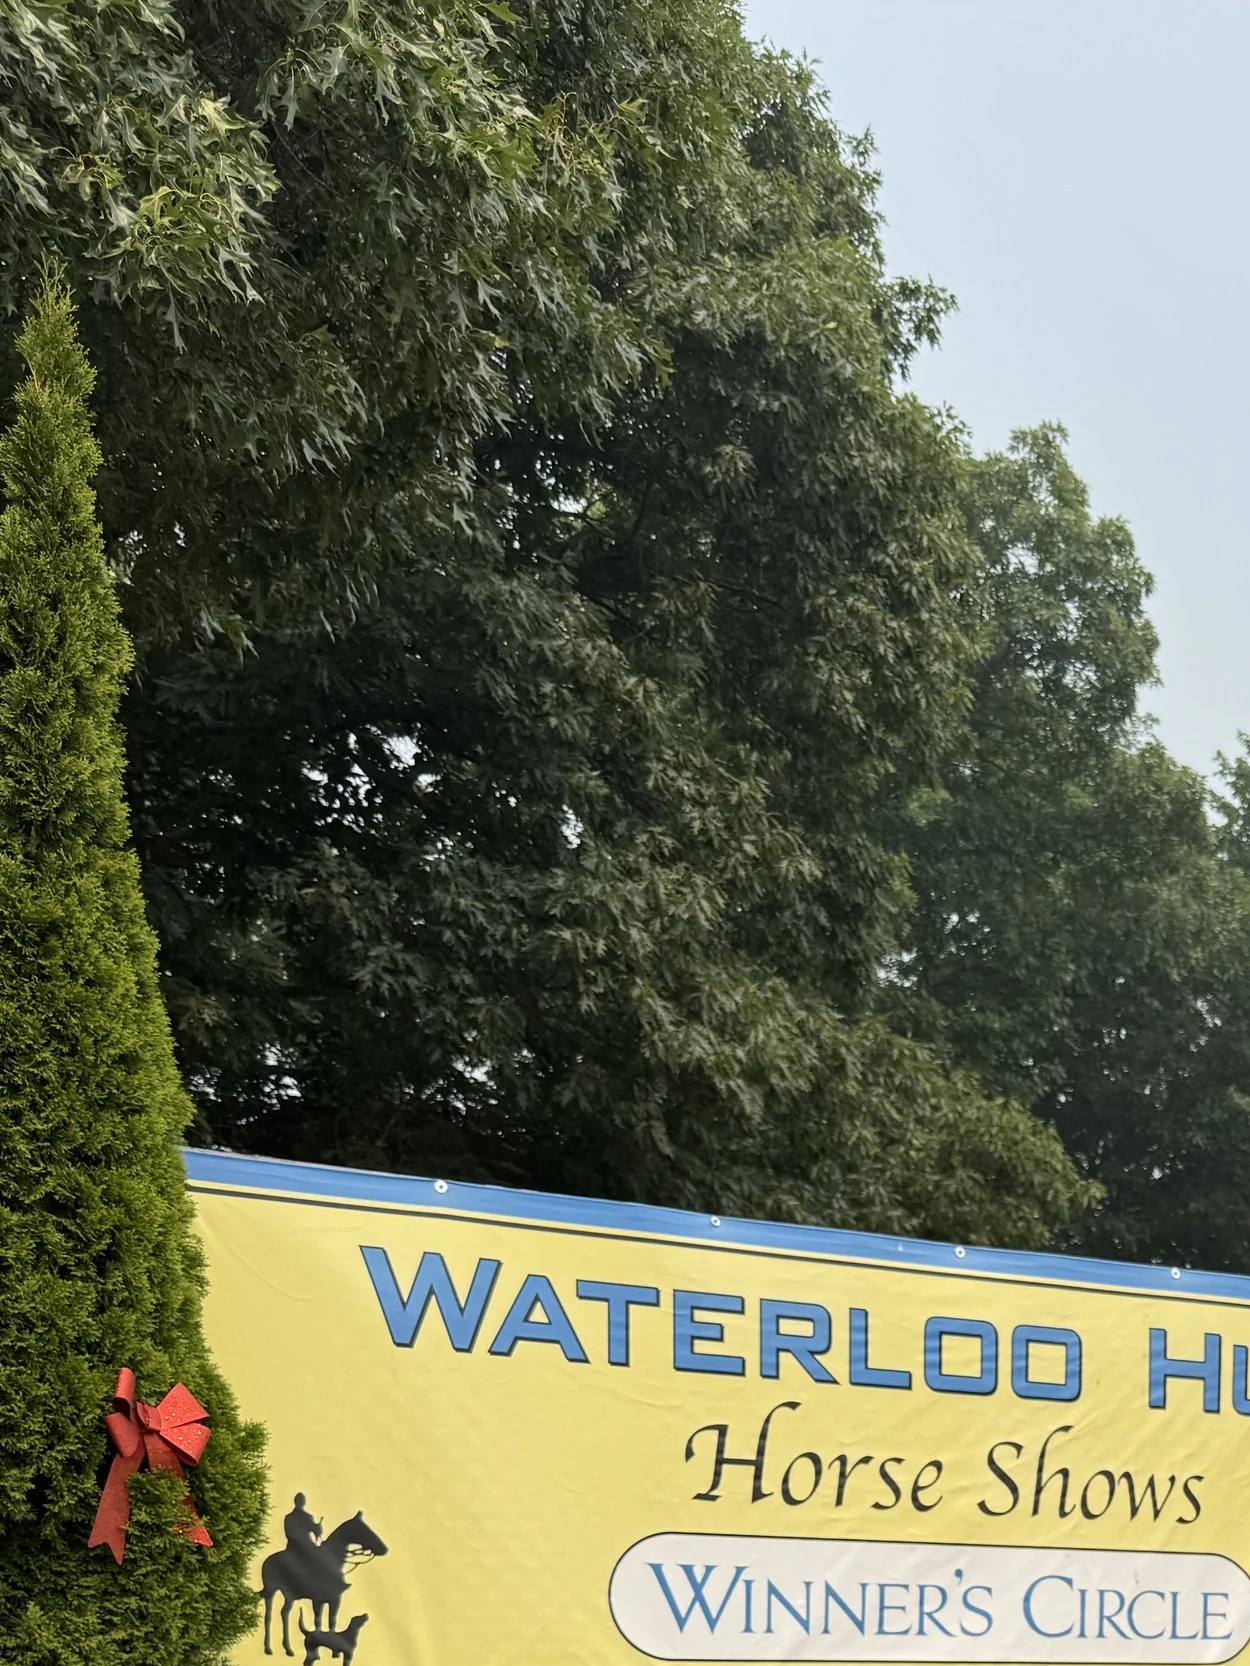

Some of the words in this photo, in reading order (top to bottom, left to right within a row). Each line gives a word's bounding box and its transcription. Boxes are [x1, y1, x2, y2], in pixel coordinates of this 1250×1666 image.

[360, 1244, 1083, 1402] WATERLOO
[684, 1401, 944, 1512] Horse
[977, 1426, 1205, 1525] Shows
[649, 1562, 994, 1640] WINNER'S
[1023, 1576, 1233, 1640] CIRCLE
